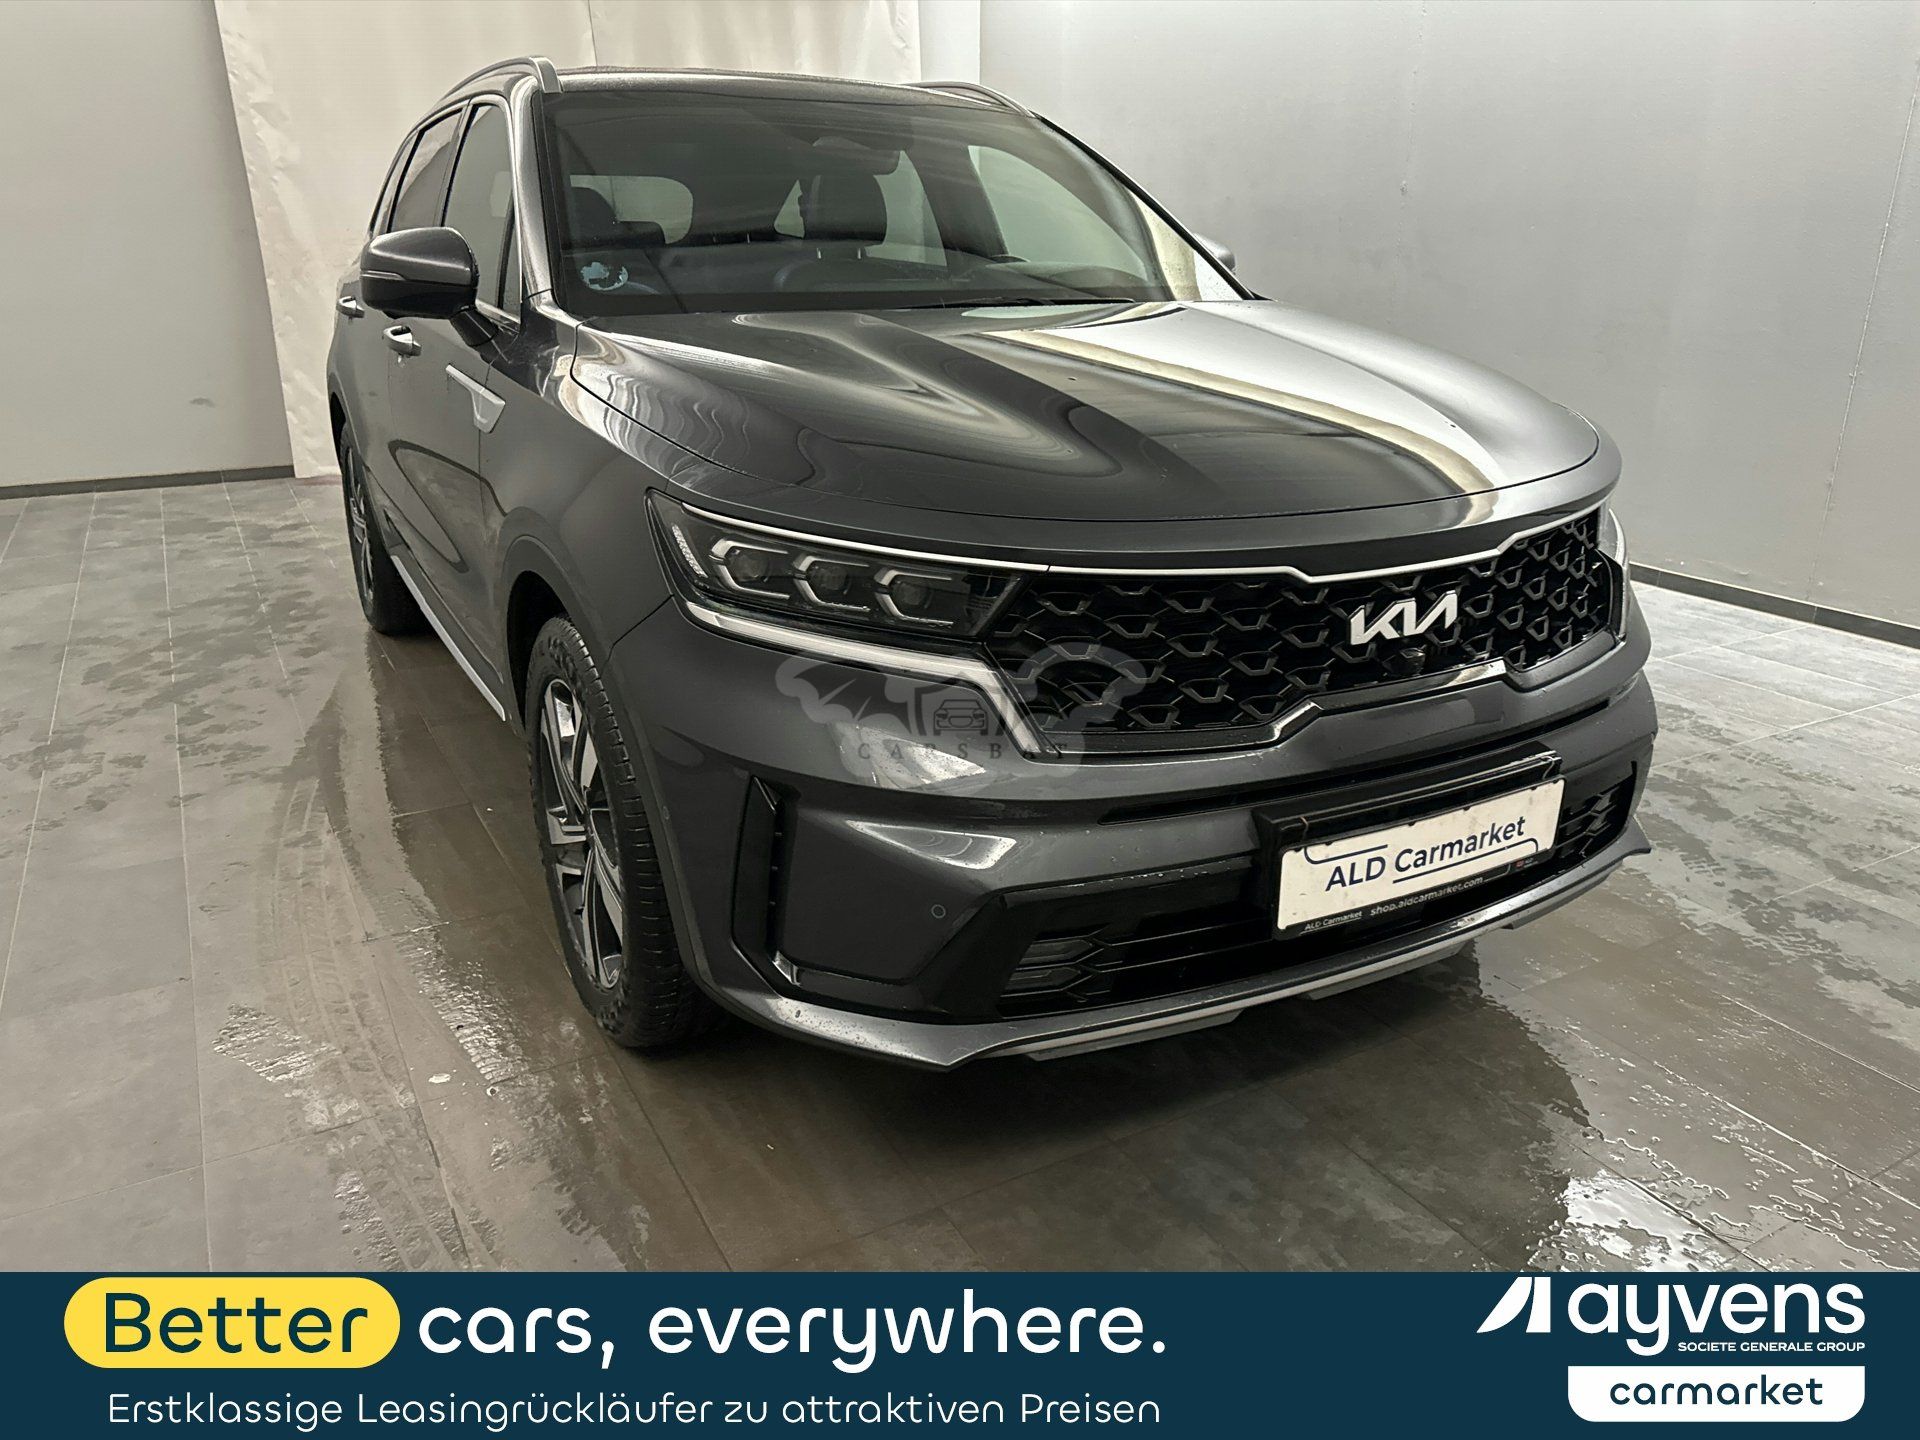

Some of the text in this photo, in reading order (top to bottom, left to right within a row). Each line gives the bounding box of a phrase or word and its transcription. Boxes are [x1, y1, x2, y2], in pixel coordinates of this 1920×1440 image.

[1350, 590, 1457, 646] KIA
[1325, 816, 1526, 892] ALD Carmarket
[1304, 910, 1363, 931] ALD Carmarket
